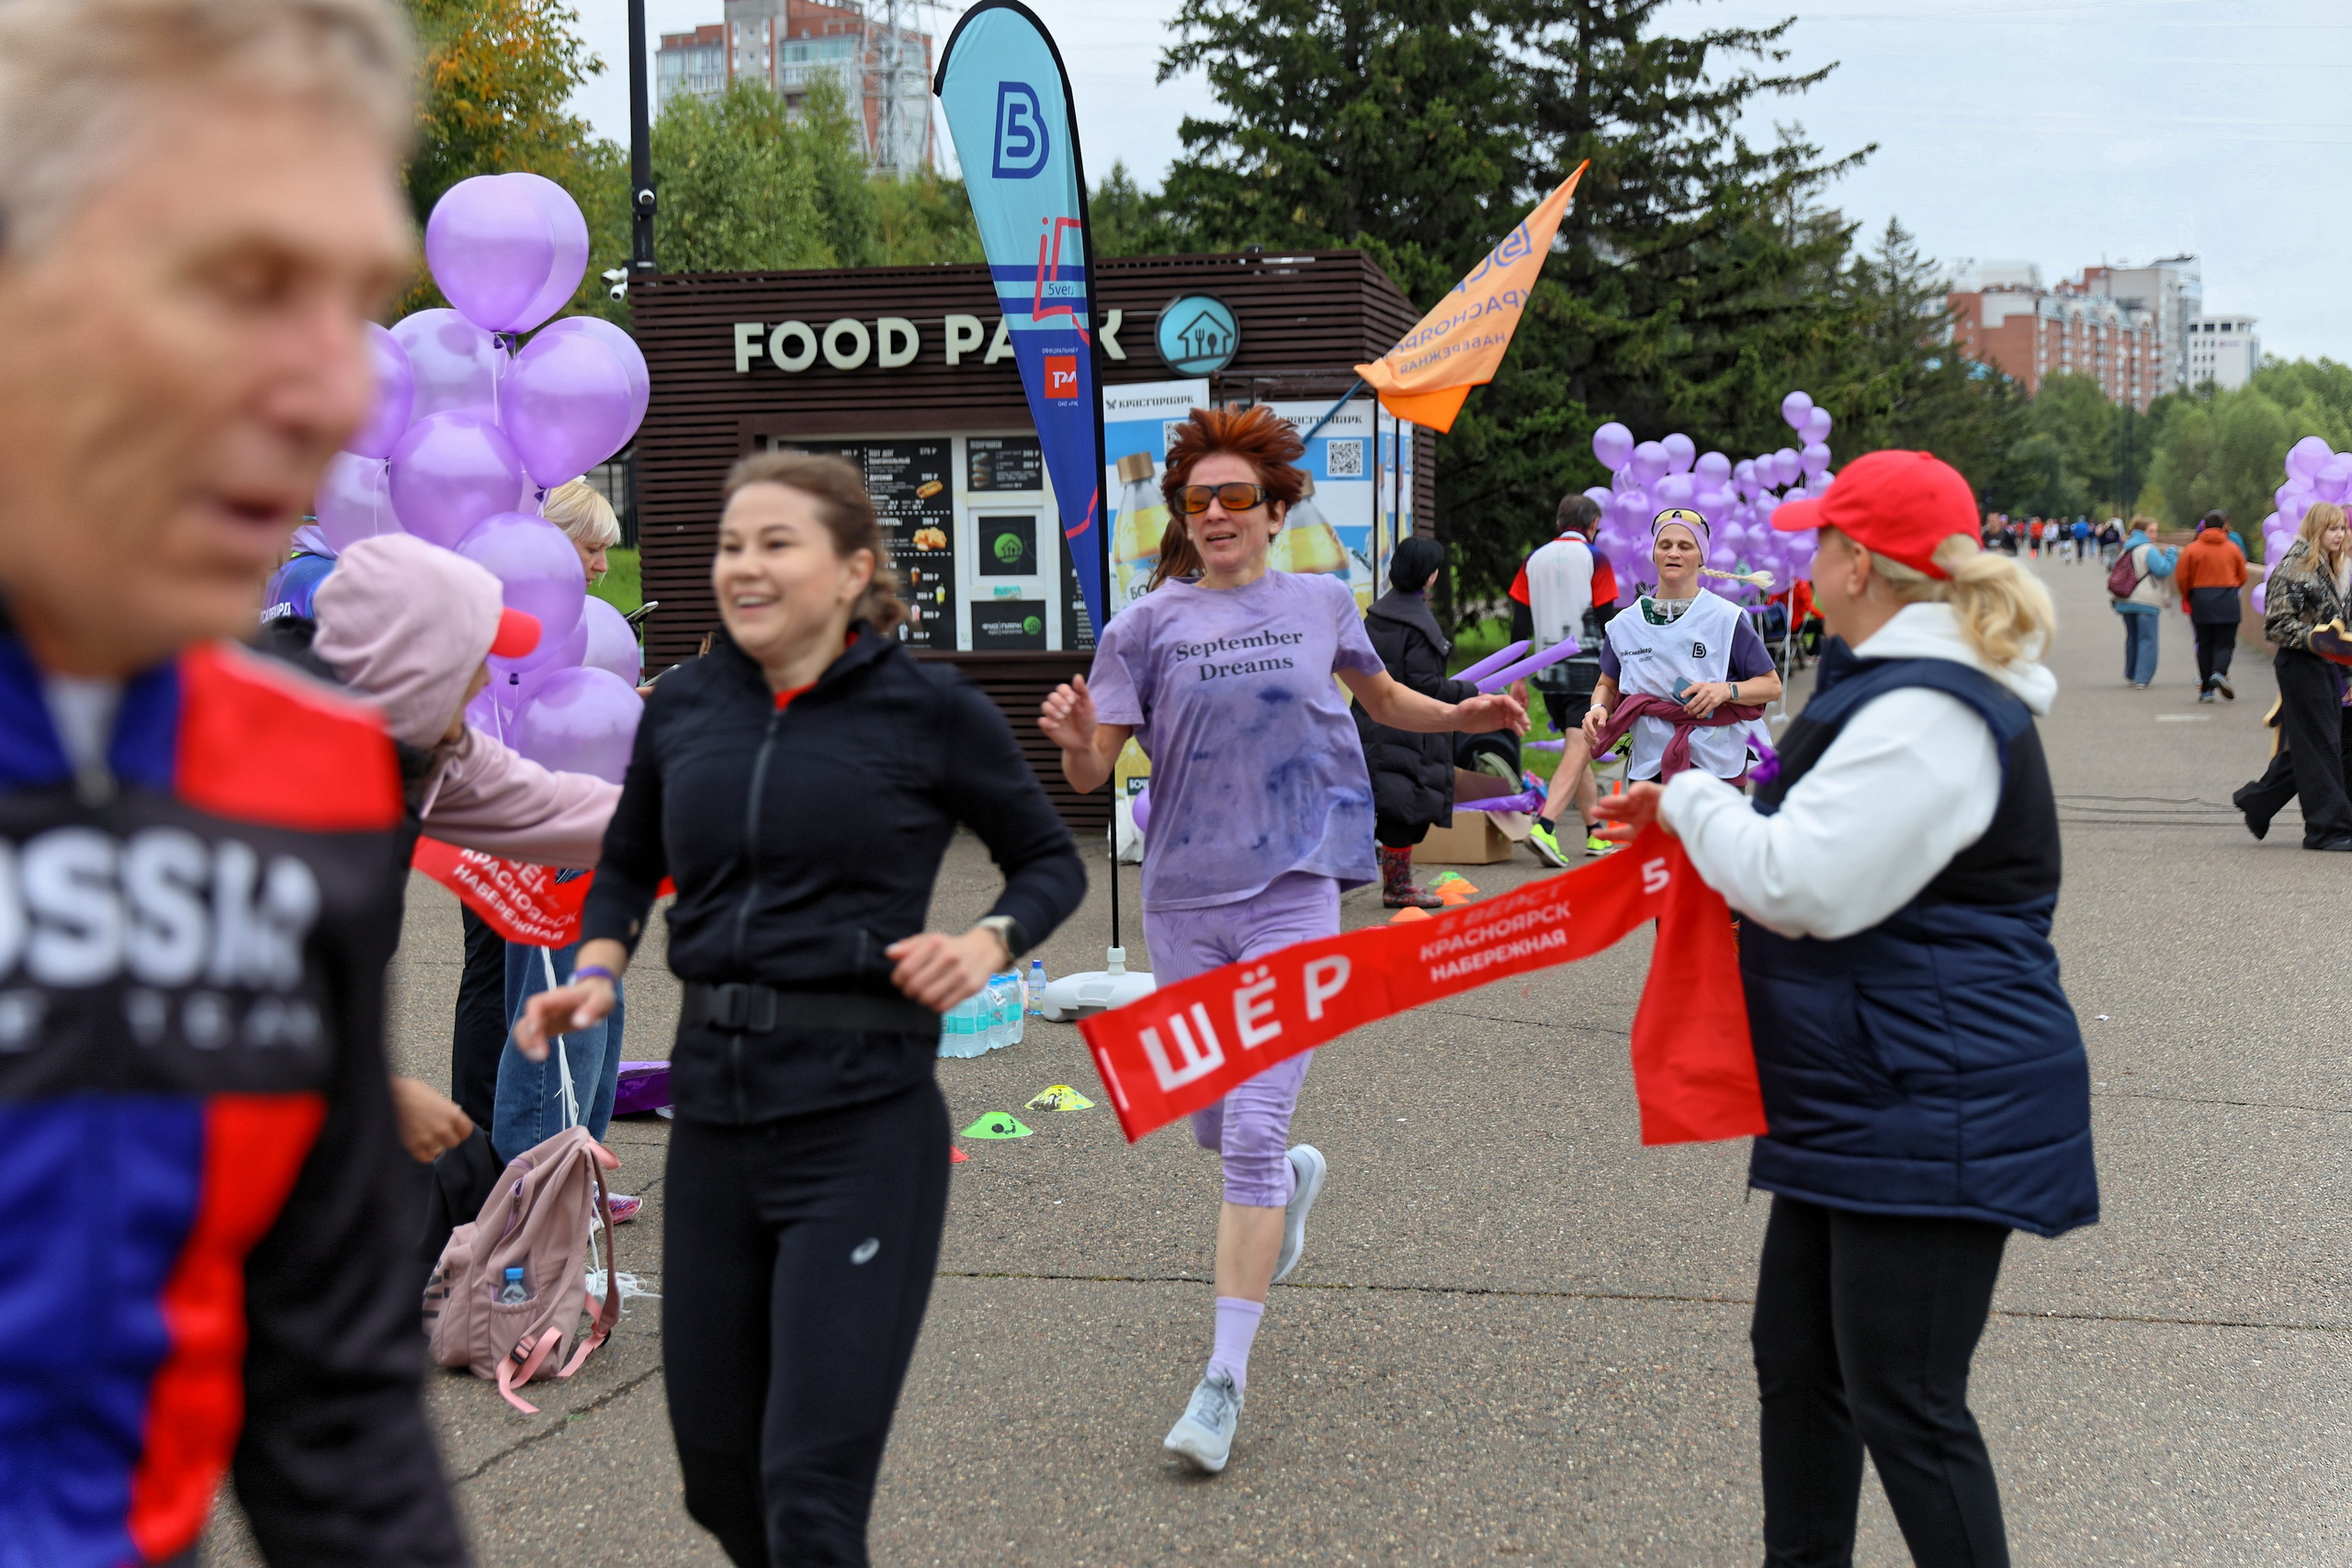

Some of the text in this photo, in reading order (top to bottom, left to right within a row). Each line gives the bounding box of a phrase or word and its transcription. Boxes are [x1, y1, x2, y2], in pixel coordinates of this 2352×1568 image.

[734, 309, 1126, 373] FOOD PAK
[1176, 630, 1303, 661] September
[1620, 647, 1652, 657] ейсмейкер
[1198, 657, 1294, 682] Dreams
[1642, 857, 1670, 895] 5
[453, 863, 565, 941] НАБЕРЕЖНАЯ
[1419, 900, 1572, 962] КРАСНОЯРСК
[1430, 929, 1567, 983] НАБЕРЕЖНАЯ
